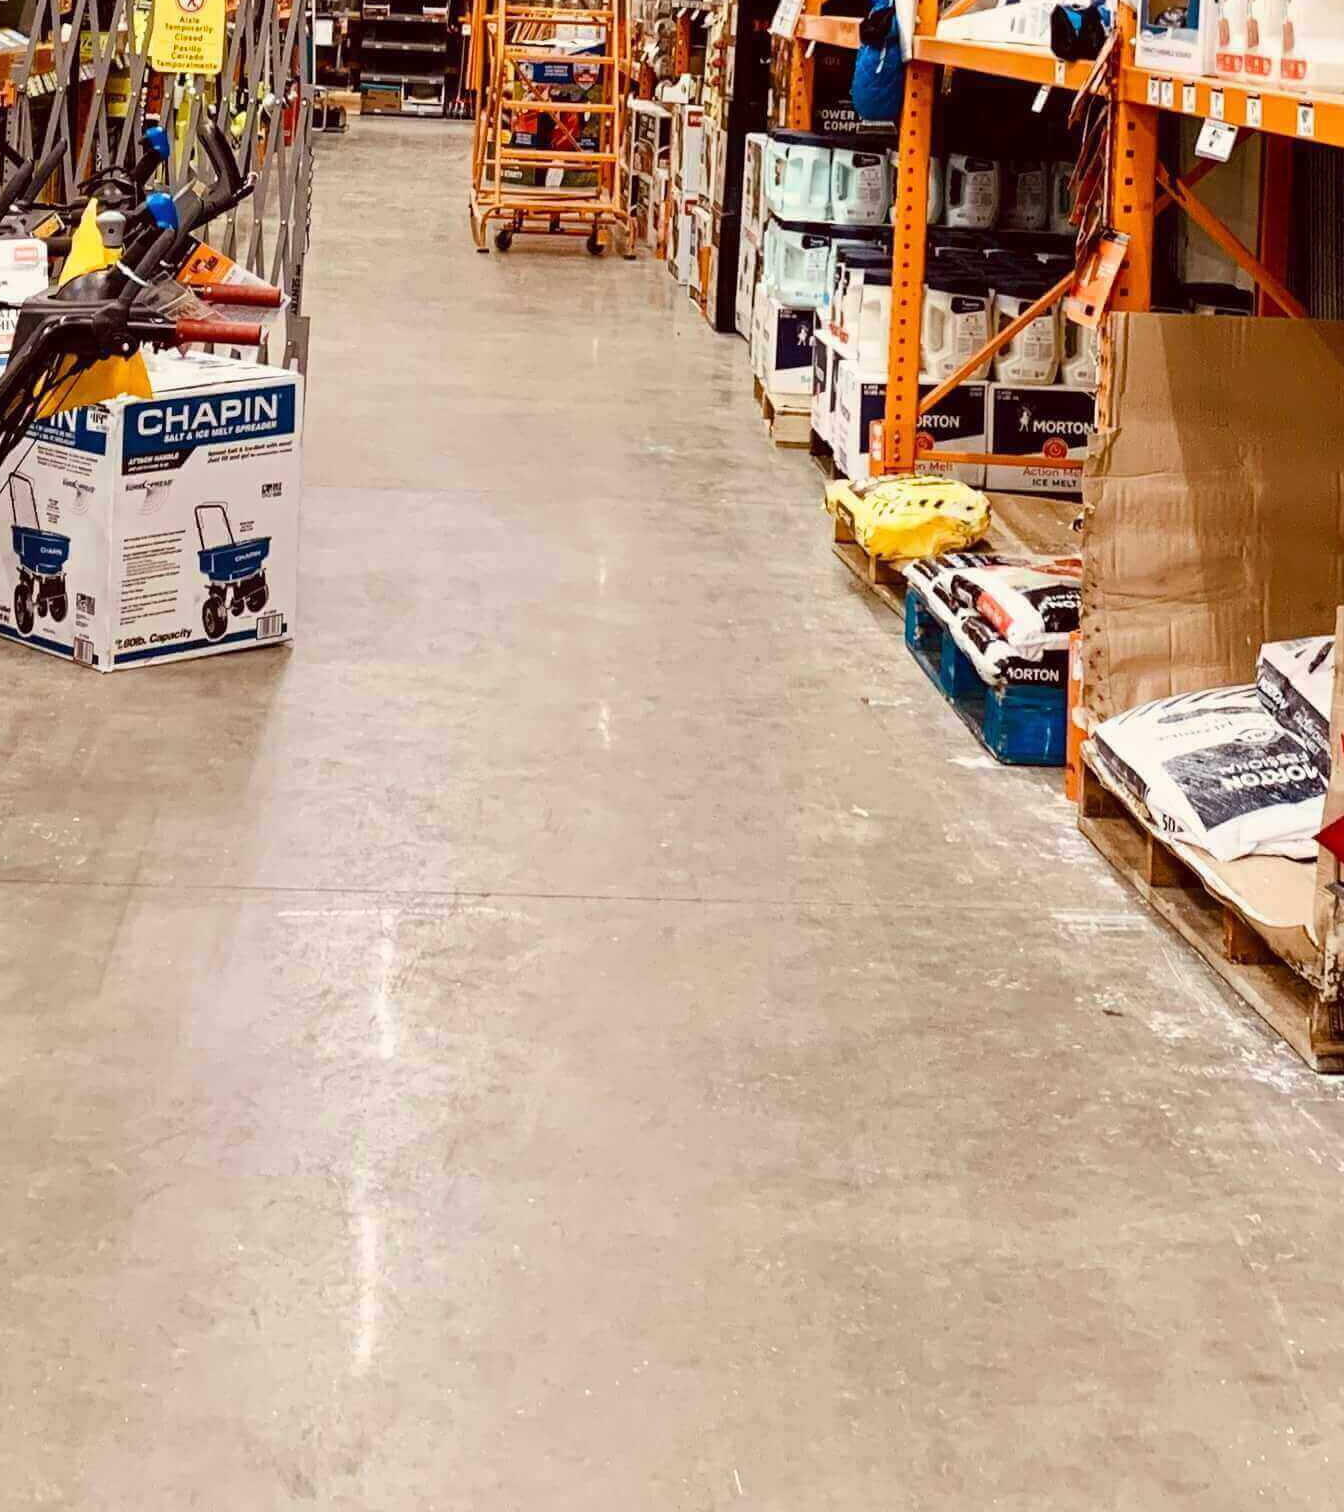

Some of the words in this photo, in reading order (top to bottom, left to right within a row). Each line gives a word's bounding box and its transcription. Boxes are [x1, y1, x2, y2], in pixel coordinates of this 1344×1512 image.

[175, 34, 203, 42] Closed
[174, 44, 202, 53] Pasillo
[137, 394, 278, 436] CHAPIN
[916, 414, 960, 429] ORTON
[164, 432, 185, 443] SALT
[196, 430, 210, 439] ICE
[211, 427, 234, 437] MELT
[235, 420, 277, 433] SPREADER
[1033, 420, 1095, 434] MORTON
[924, 462, 953, 472] Melt
[1023, 466, 1060, 478] Action
[1032, 478, 1048, 487] ICE
[1052, 478, 1077, 488] MELT
[149, 627, 192, 643] Capacity
